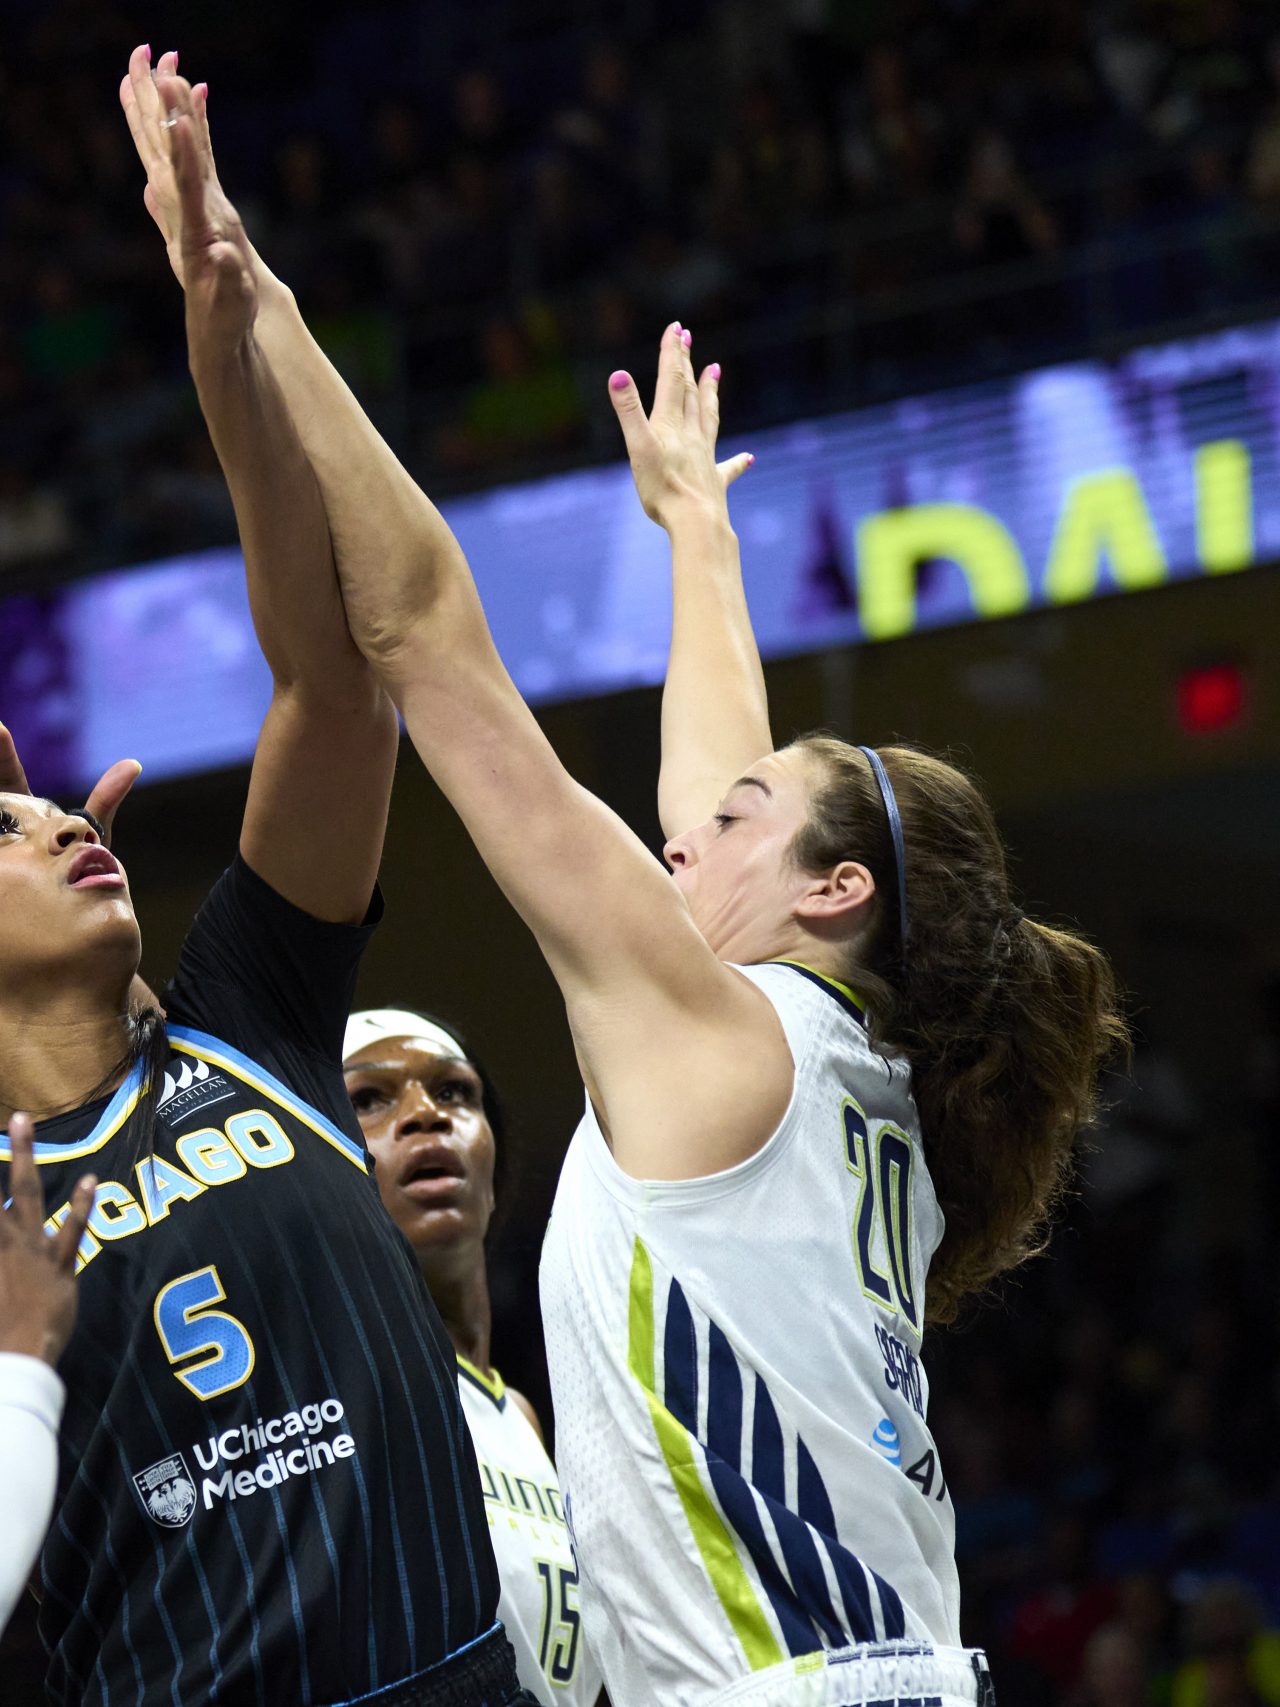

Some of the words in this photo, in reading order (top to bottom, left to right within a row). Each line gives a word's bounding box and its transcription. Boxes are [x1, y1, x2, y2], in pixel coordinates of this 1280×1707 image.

[159, 1077, 228, 1119] MAGELLAN
[42, 1109, 295, 1277] ICAGO
[841, 1096, 921, 1339] 20
[154, 1264, 256, 1401] 5
[192, 1399, 344, 1471] UChicago
[202, 1434, 356, 1511] Medicine
[533, 1556, 581, 1688] 15
